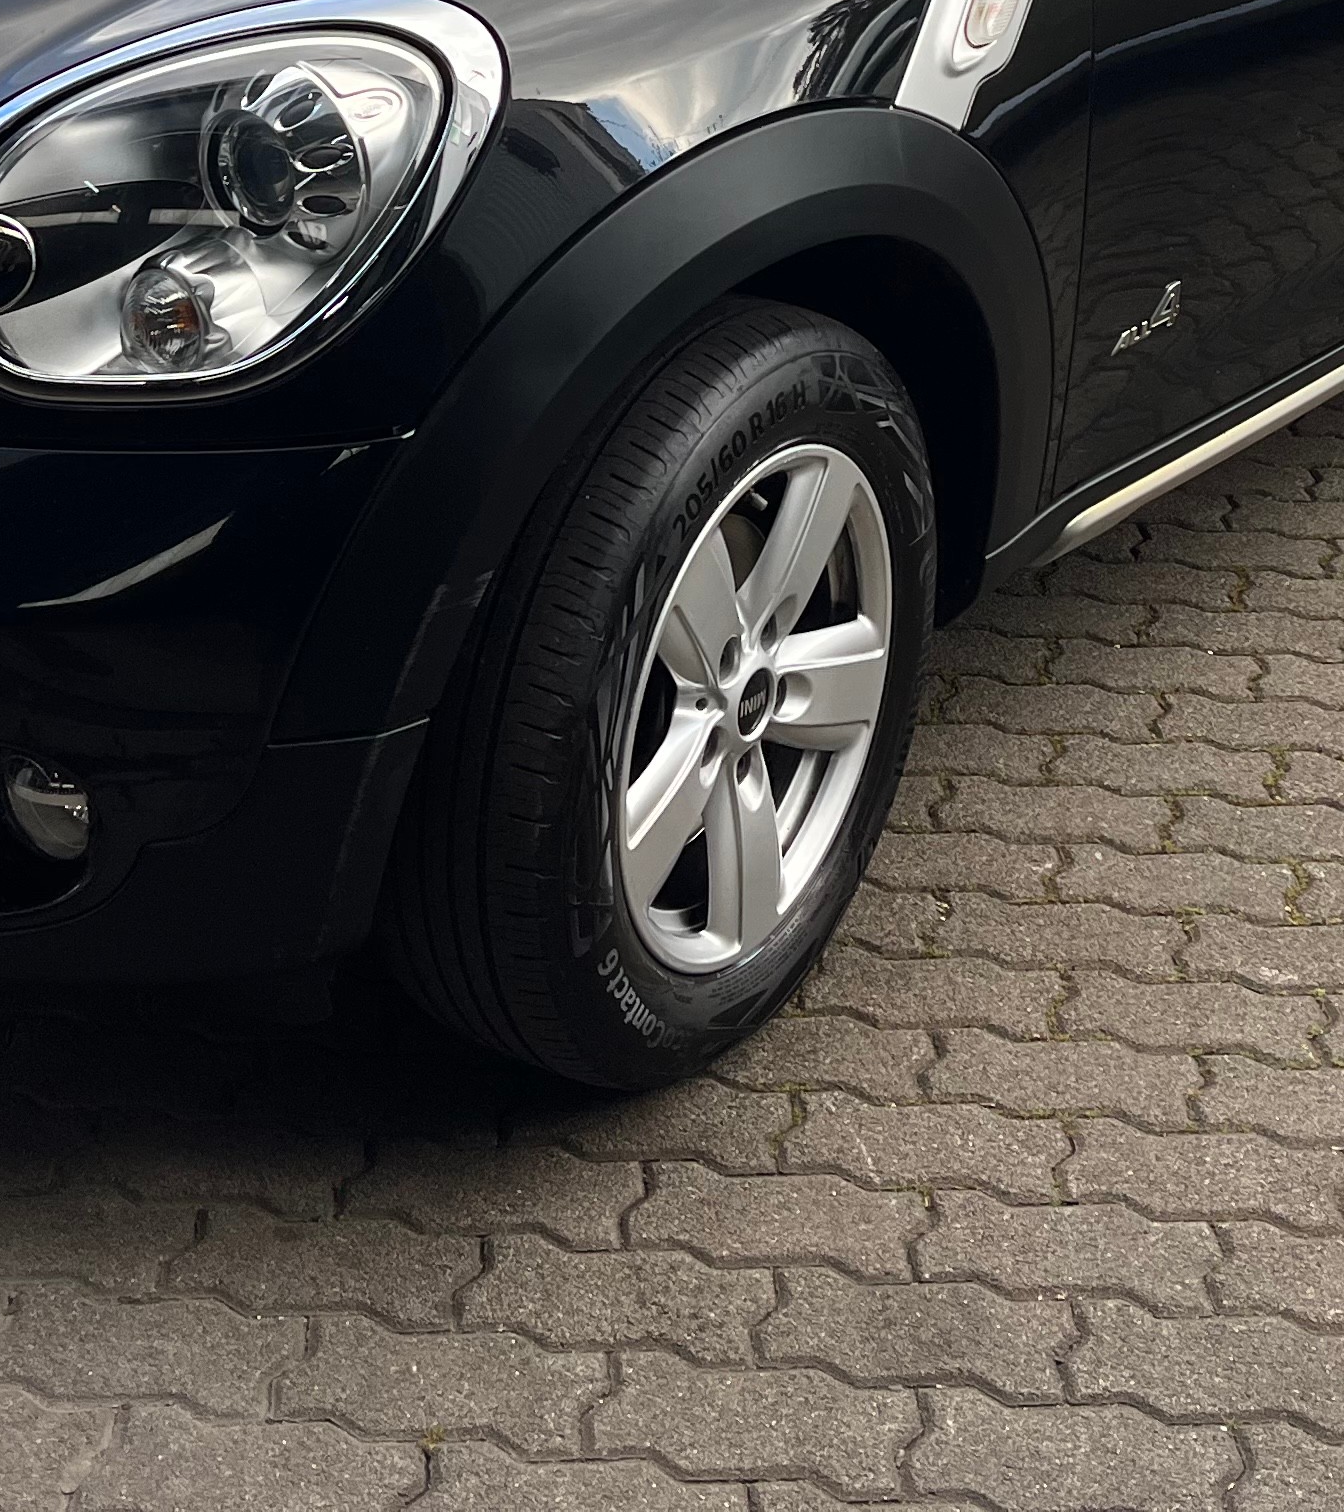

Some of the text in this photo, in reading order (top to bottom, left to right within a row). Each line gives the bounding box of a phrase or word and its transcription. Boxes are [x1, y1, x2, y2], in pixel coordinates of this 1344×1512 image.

[672, 430, 747, 542] 205/60
[739, 688, 768, 719] MINI
[597, 948, 619, 976] 6
